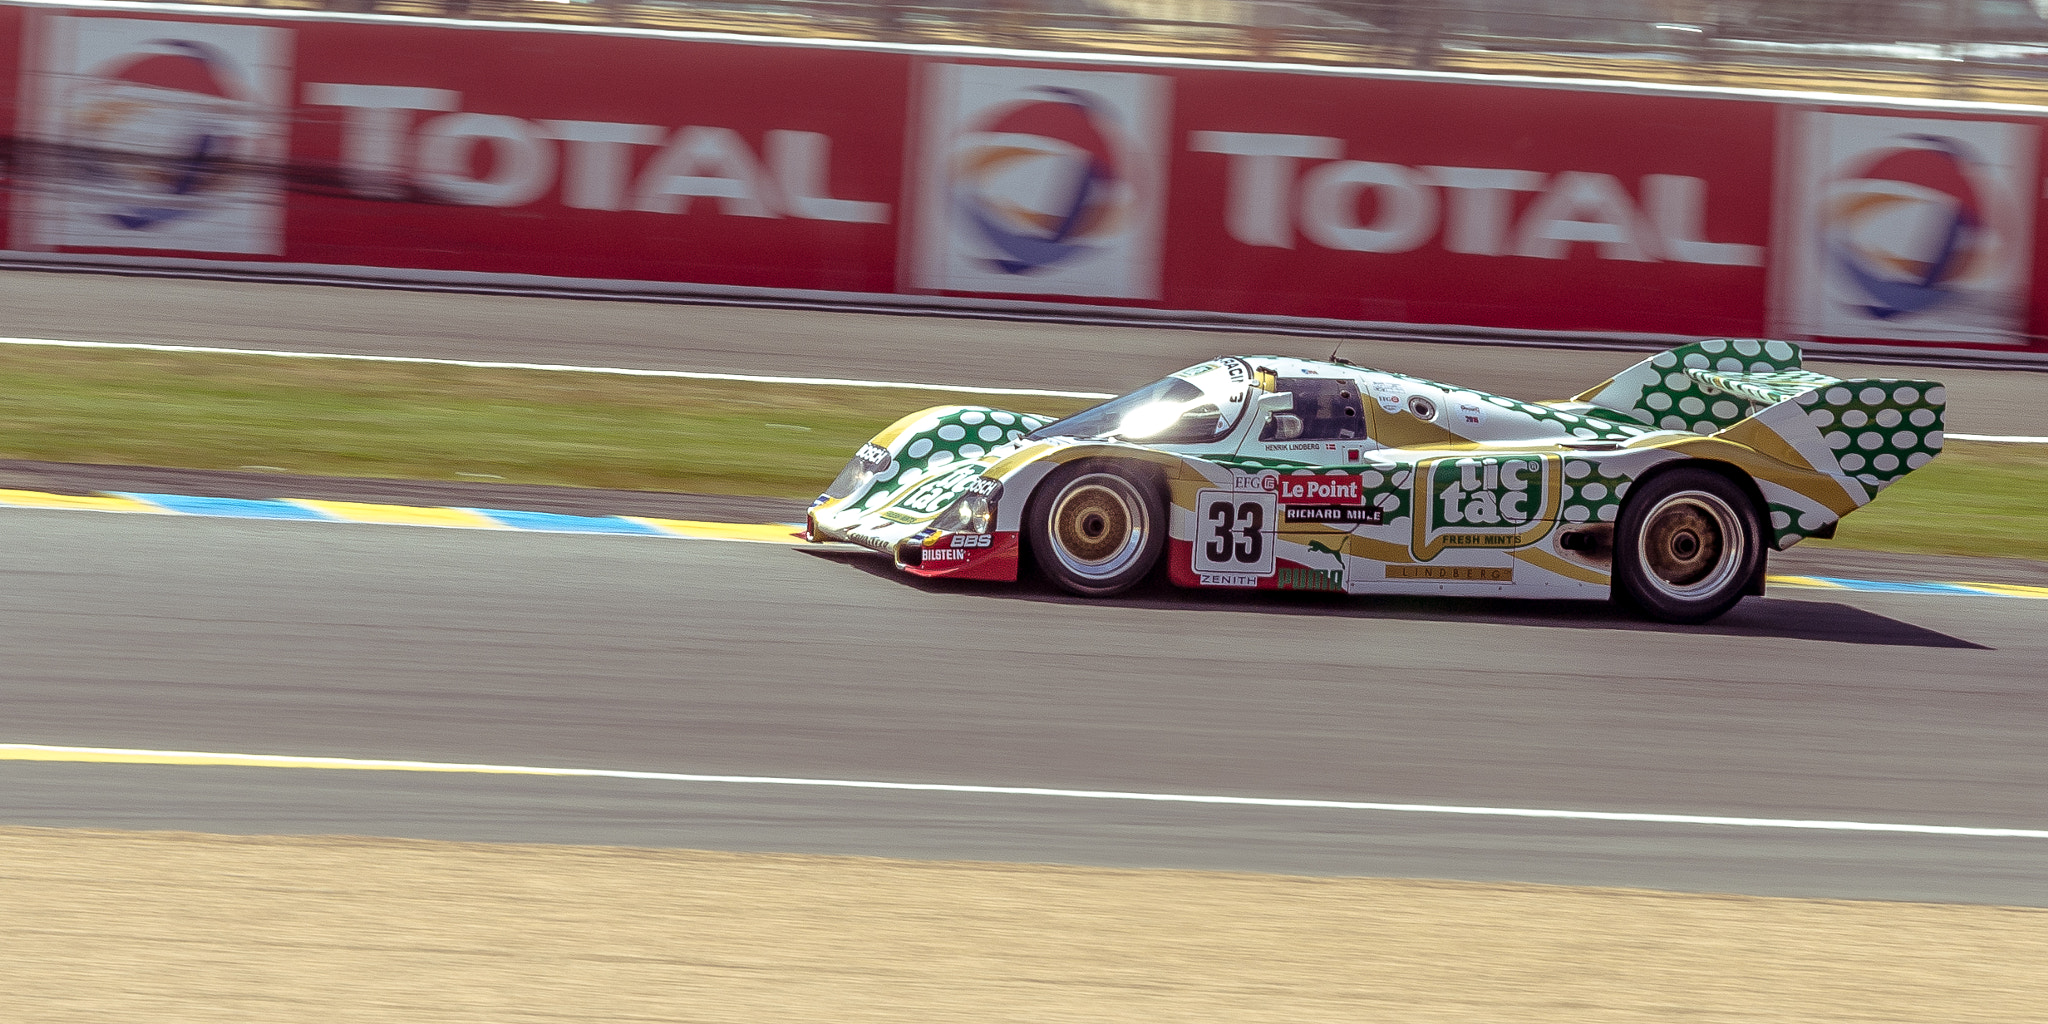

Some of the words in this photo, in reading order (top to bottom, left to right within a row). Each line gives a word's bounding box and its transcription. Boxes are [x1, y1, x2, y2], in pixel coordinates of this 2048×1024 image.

[300, 82, 894, 225] TOTAL
[1186, 130, 1768, 267] TOTAL
[1289, 443, 1320, 451] LINDBERG
[1455, 457, 1527, 491] tic
[1235, 477, 1260, 489] EFG
[1282, 480, 1305, 498] Le
[1307, 480, 1359, 499] Point
[1440, 480, 1528, 524] tac
[1287, 508, 1341, 519] RICHARD
[1206, 501, 1264, 564] 33
[950, 534, 991, 548] BBS
[1442, 535, 1480, 544] FRESH
[1484, 535, 1522, 545] MINTS
[921, 548, 964, 561] BILSTEIN
[1201, 575, 1257, 586] ZENITH
[1277, 567, 1343, 591] PUMA
[1402, 568, 1500, 579] LINDBERG
